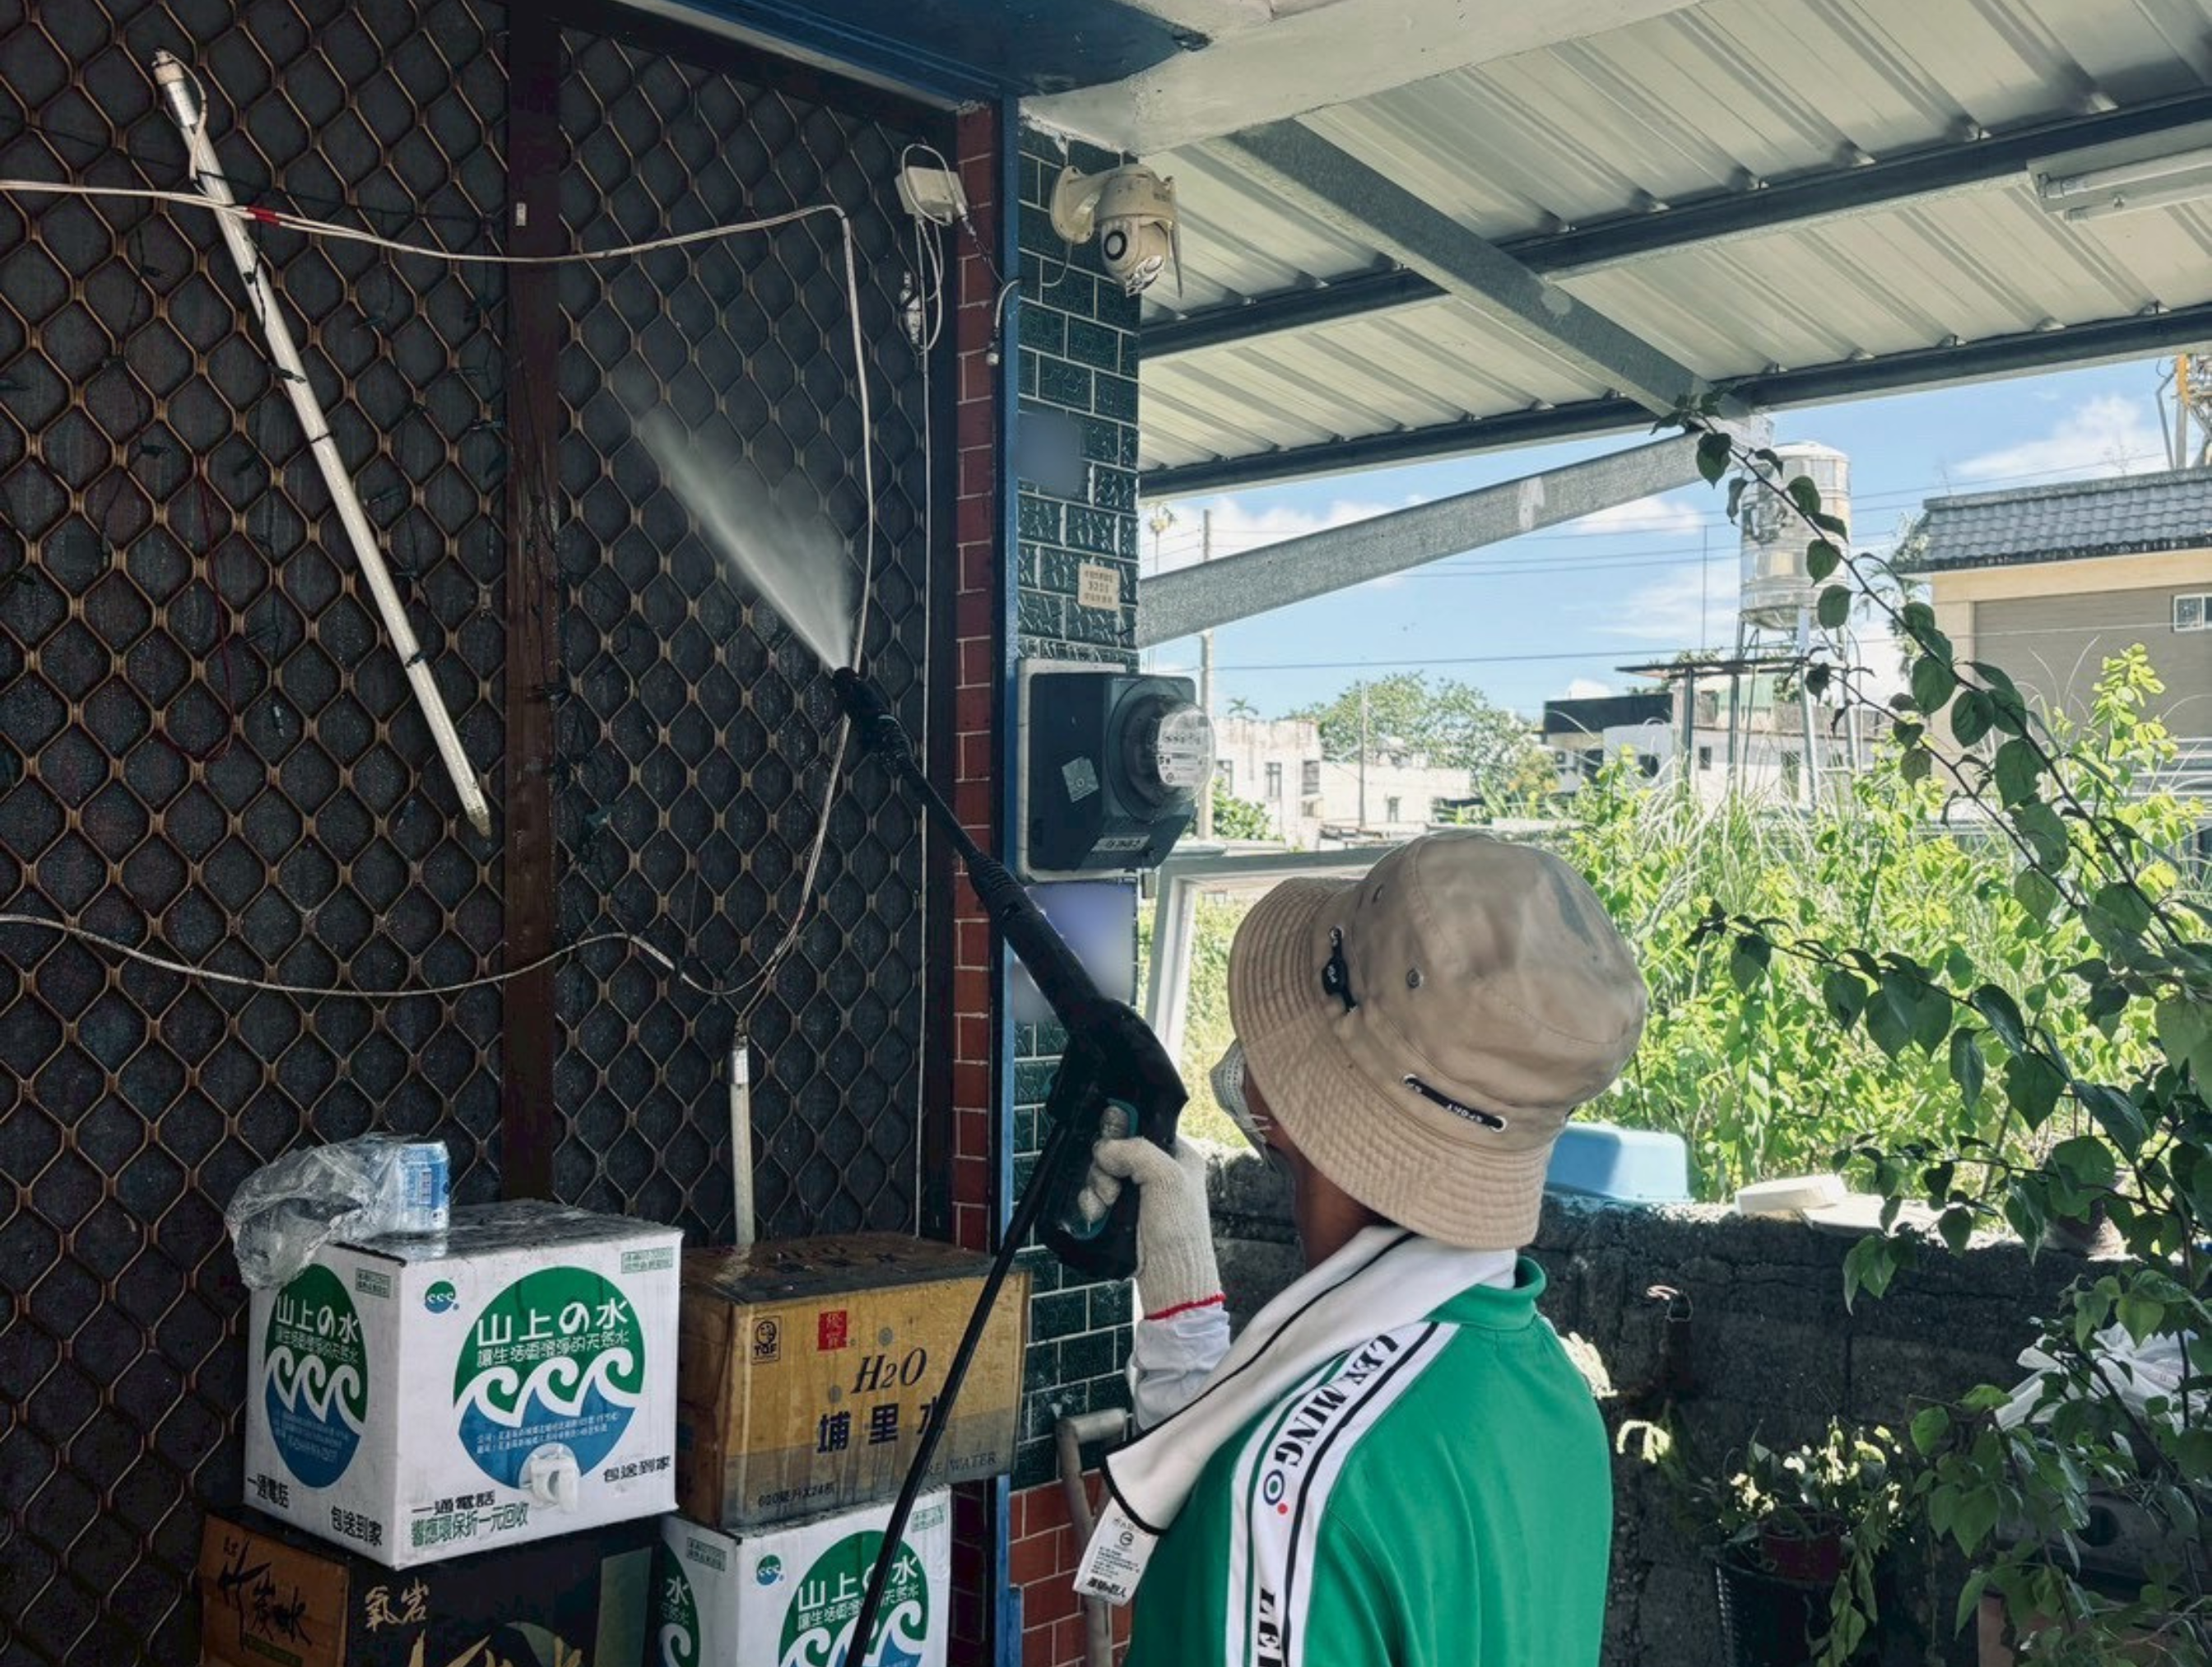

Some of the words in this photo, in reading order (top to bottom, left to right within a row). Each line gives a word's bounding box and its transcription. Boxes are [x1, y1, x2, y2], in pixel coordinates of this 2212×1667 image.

[276, 1293, 359, 1344] 山上の水
[476, 1297, 629, 1347] 山上の水
[851, 1346, 928, 1395] H2O
[1274, 1383, 1350, 1467] MING
[603, 1455, 671, 1483] 包送到家
[331, 1505, 382, 1547] 包送到家
[411, 1491, 495, 1516] 一通電話
